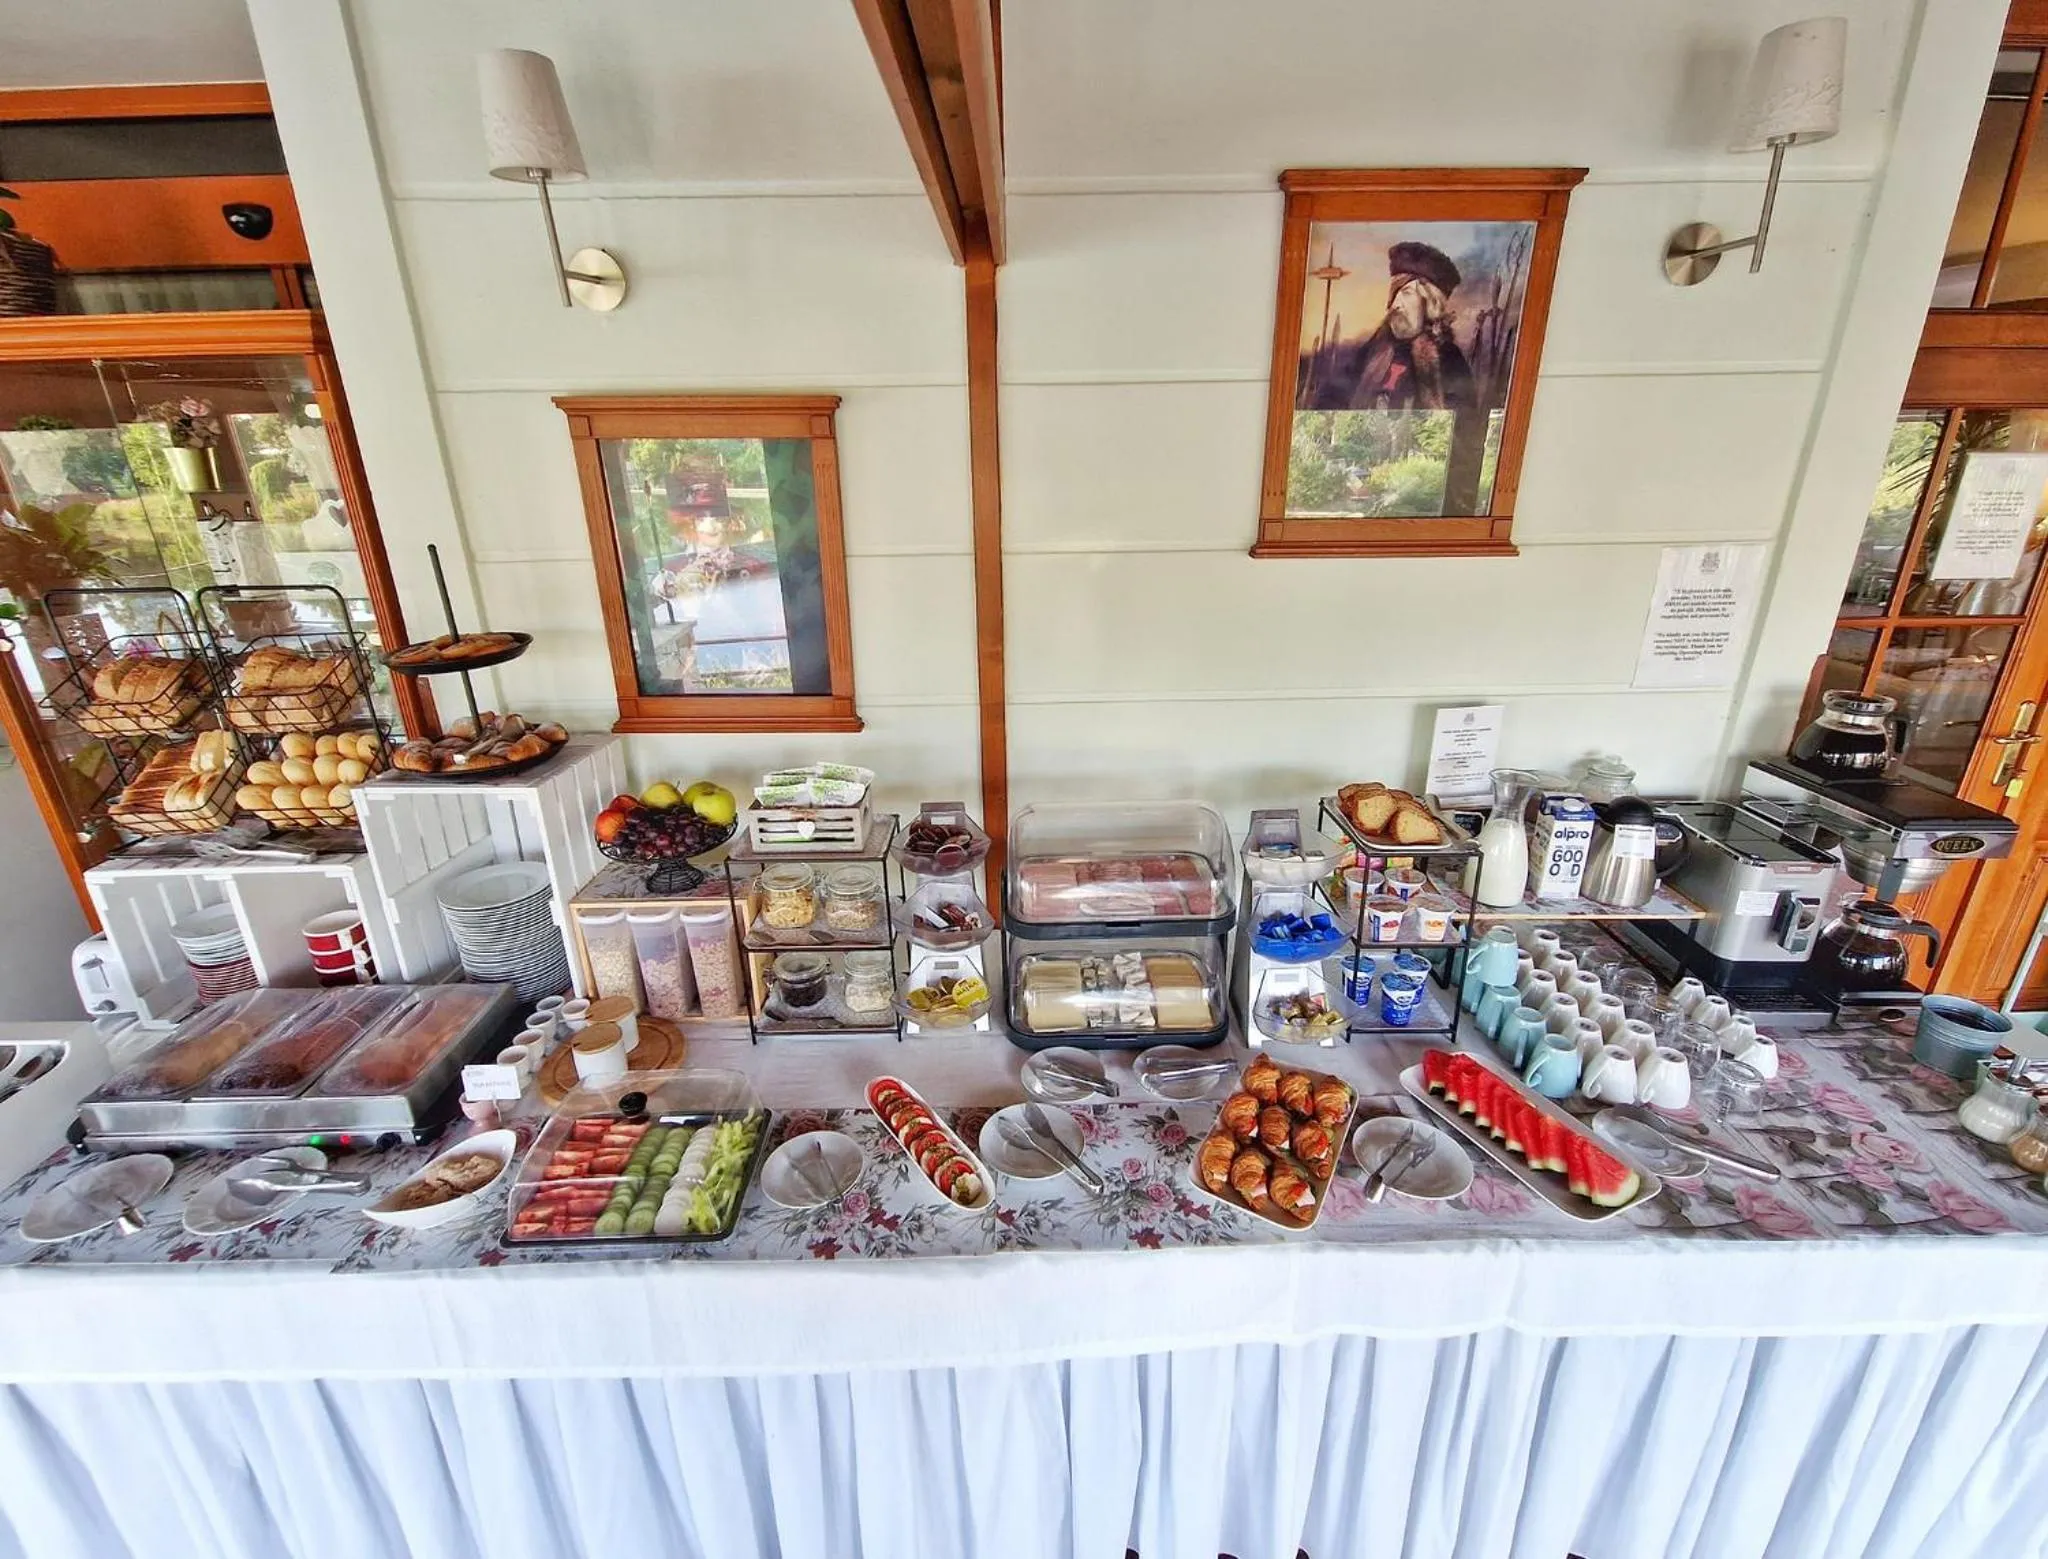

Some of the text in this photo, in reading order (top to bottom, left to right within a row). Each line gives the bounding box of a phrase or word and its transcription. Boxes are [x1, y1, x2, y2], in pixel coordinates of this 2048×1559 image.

[1554, 827, 1590, 841] alpro
[1935, 840, 1981, 852] QUEEN
[1552, 849, 1584, 863] GOO
[1549, 863, 1581, 877] O D
